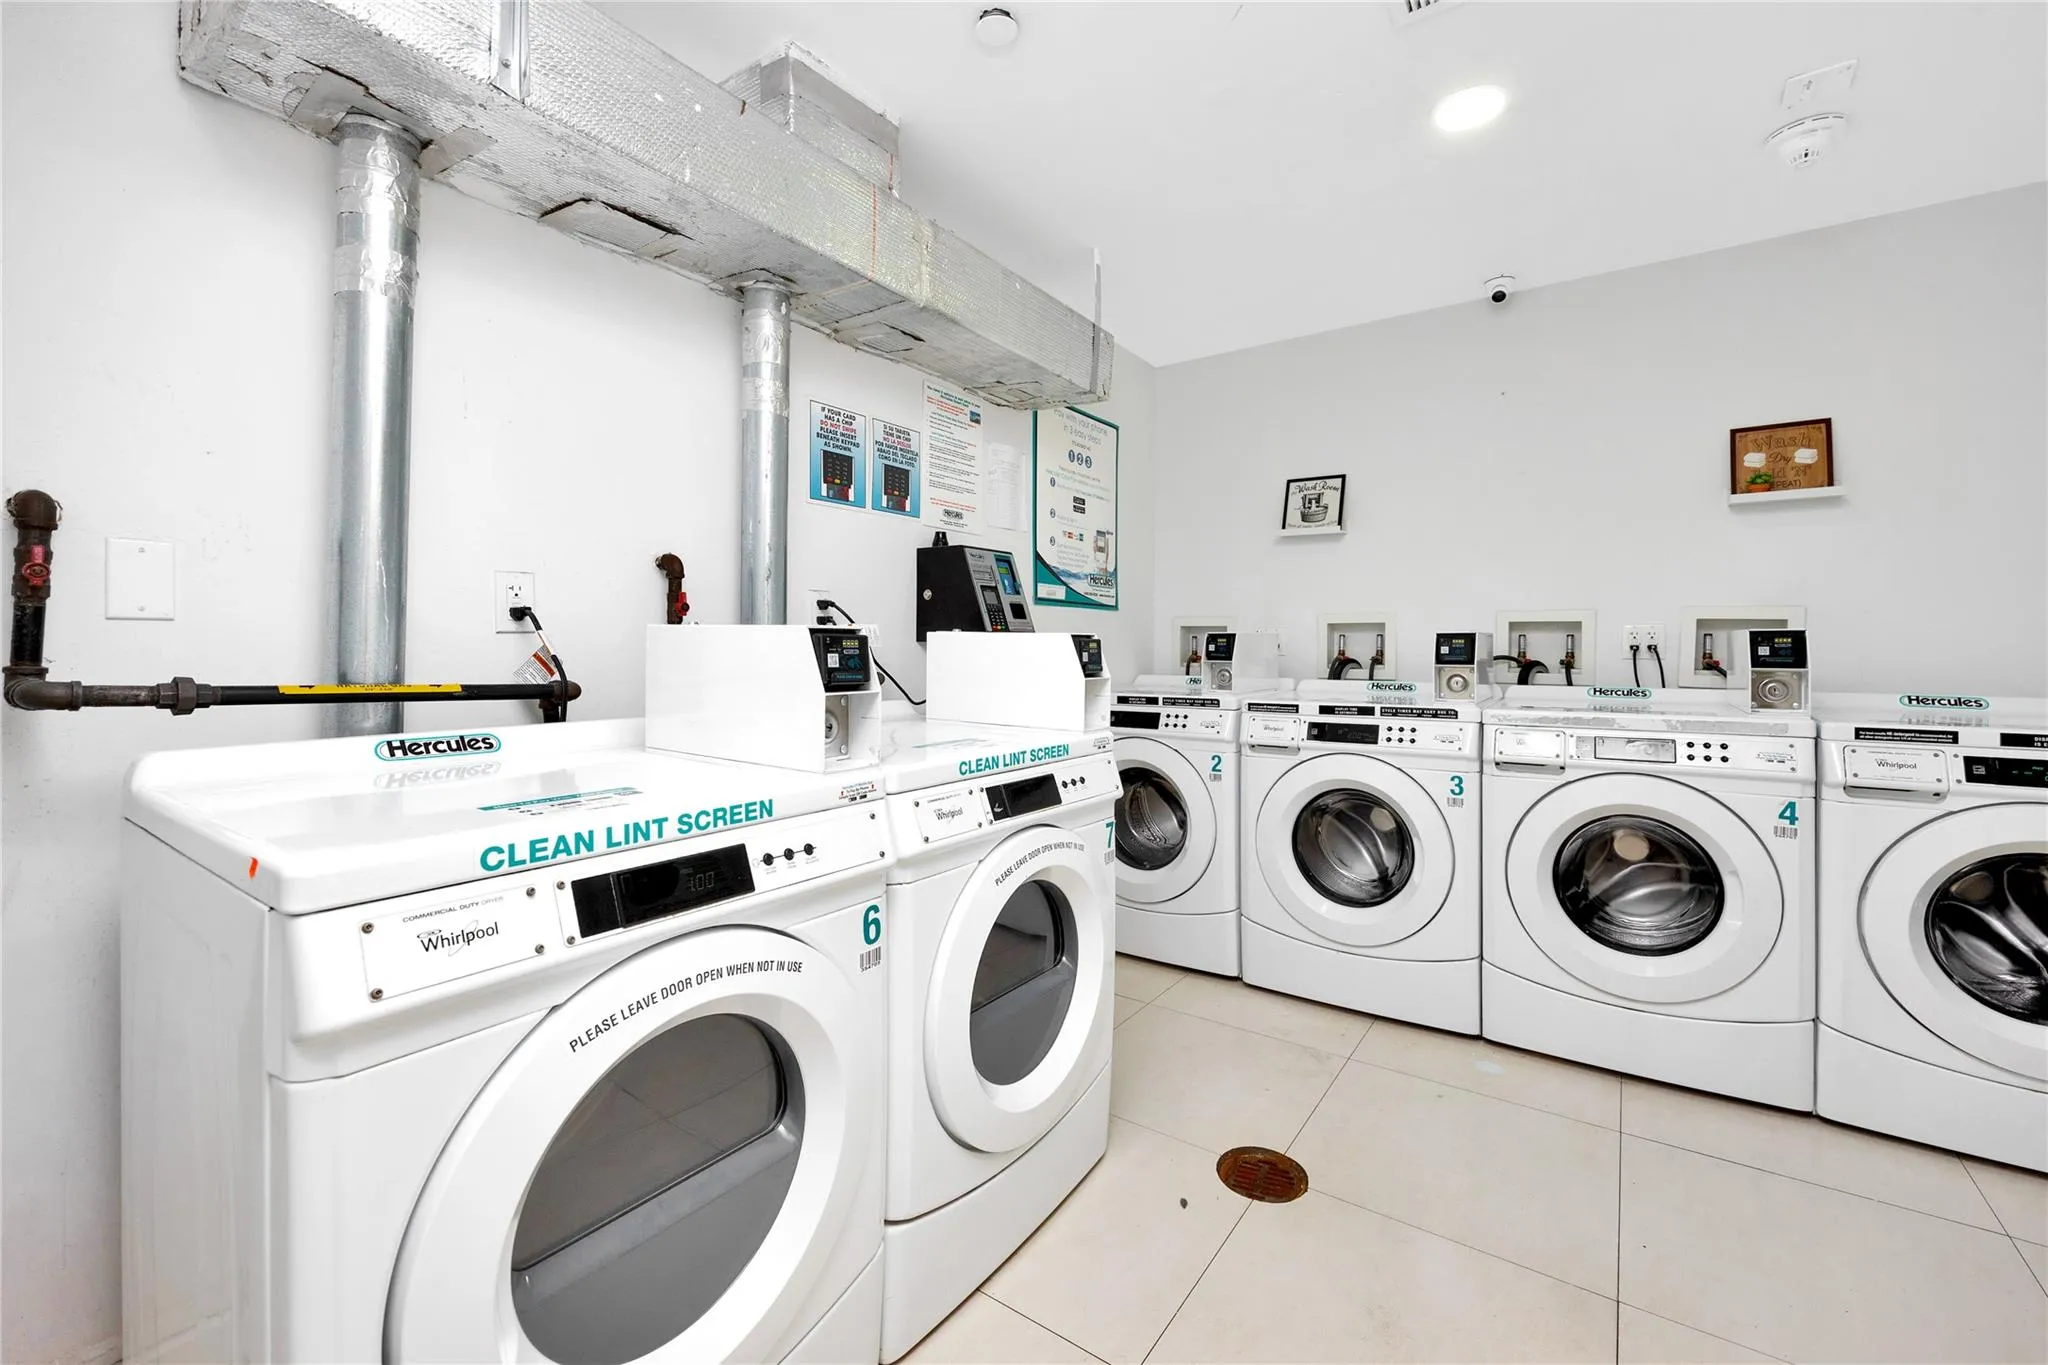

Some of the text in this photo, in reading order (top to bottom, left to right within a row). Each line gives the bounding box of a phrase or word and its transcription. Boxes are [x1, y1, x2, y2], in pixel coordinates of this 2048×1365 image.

[824, 414, 835, 422] HAS
[842, 418, 853, 426] CHIP
[827, 408, 842, 417] YOUR
[842, 412, 856, 421] CARD
[820, 419, 857, 434] DO NOT SWIPE
[820, 426, 857, 440] PLEASE INSERT
[816, 432, 860, 448] BENEATH KEYPAD
[884, 442, 898, 451] FAVOR
[902, 435, 911, 443] CHIP
[1751, 432, 1811, 451] Wash
[877, 447, 891, 456] ABAJO
[1768, 452, 1792, 464] Dry
[1089, 574, 1114, 587] Hercules
[1371, 682, 1413, 692] Hercules
[1593, 687, 1648, 698] Hercules
[1907, 695, 1983, 709] Hercules
[387, 735, 494, 758] Hercules
[959, 744, 1070, 776] CLEAN LINT SCREEN
[1211, 755, 1222, 773] 2
[1876, 760, 1917, 770] Whirlpool
[1450, 775, 1464, 796] 3
[935, 807, 964, 821] Whirlpool
[1778, 801, 1799, 826] 4
[480, 830, 594, 872] CLEAN
[606, 817, 668, 849] LINT
[677, 799, 774, 835] SCREEN
[1105, 821, 1115, 848] 7
[994, 865, 1014, 886] PLEASE
[1013, 855, 1028, 871] LEAVE
[1027, 847, 1041, 860] DOOR
[1041, 843, 1053, 854] OPEN
[1053, 841, 1065, 850] WHEN
[402, 906, 458, 923] COMMERCIAL
[459, 901, 480, 910] DUTY
[863, 904, 881, 945] 6
[420, 922, 499, 952] Whirlpool
[569, 960, 803, 1052] PLEASE LEAVE DOOR OPEN WHEN NOT IN USE
